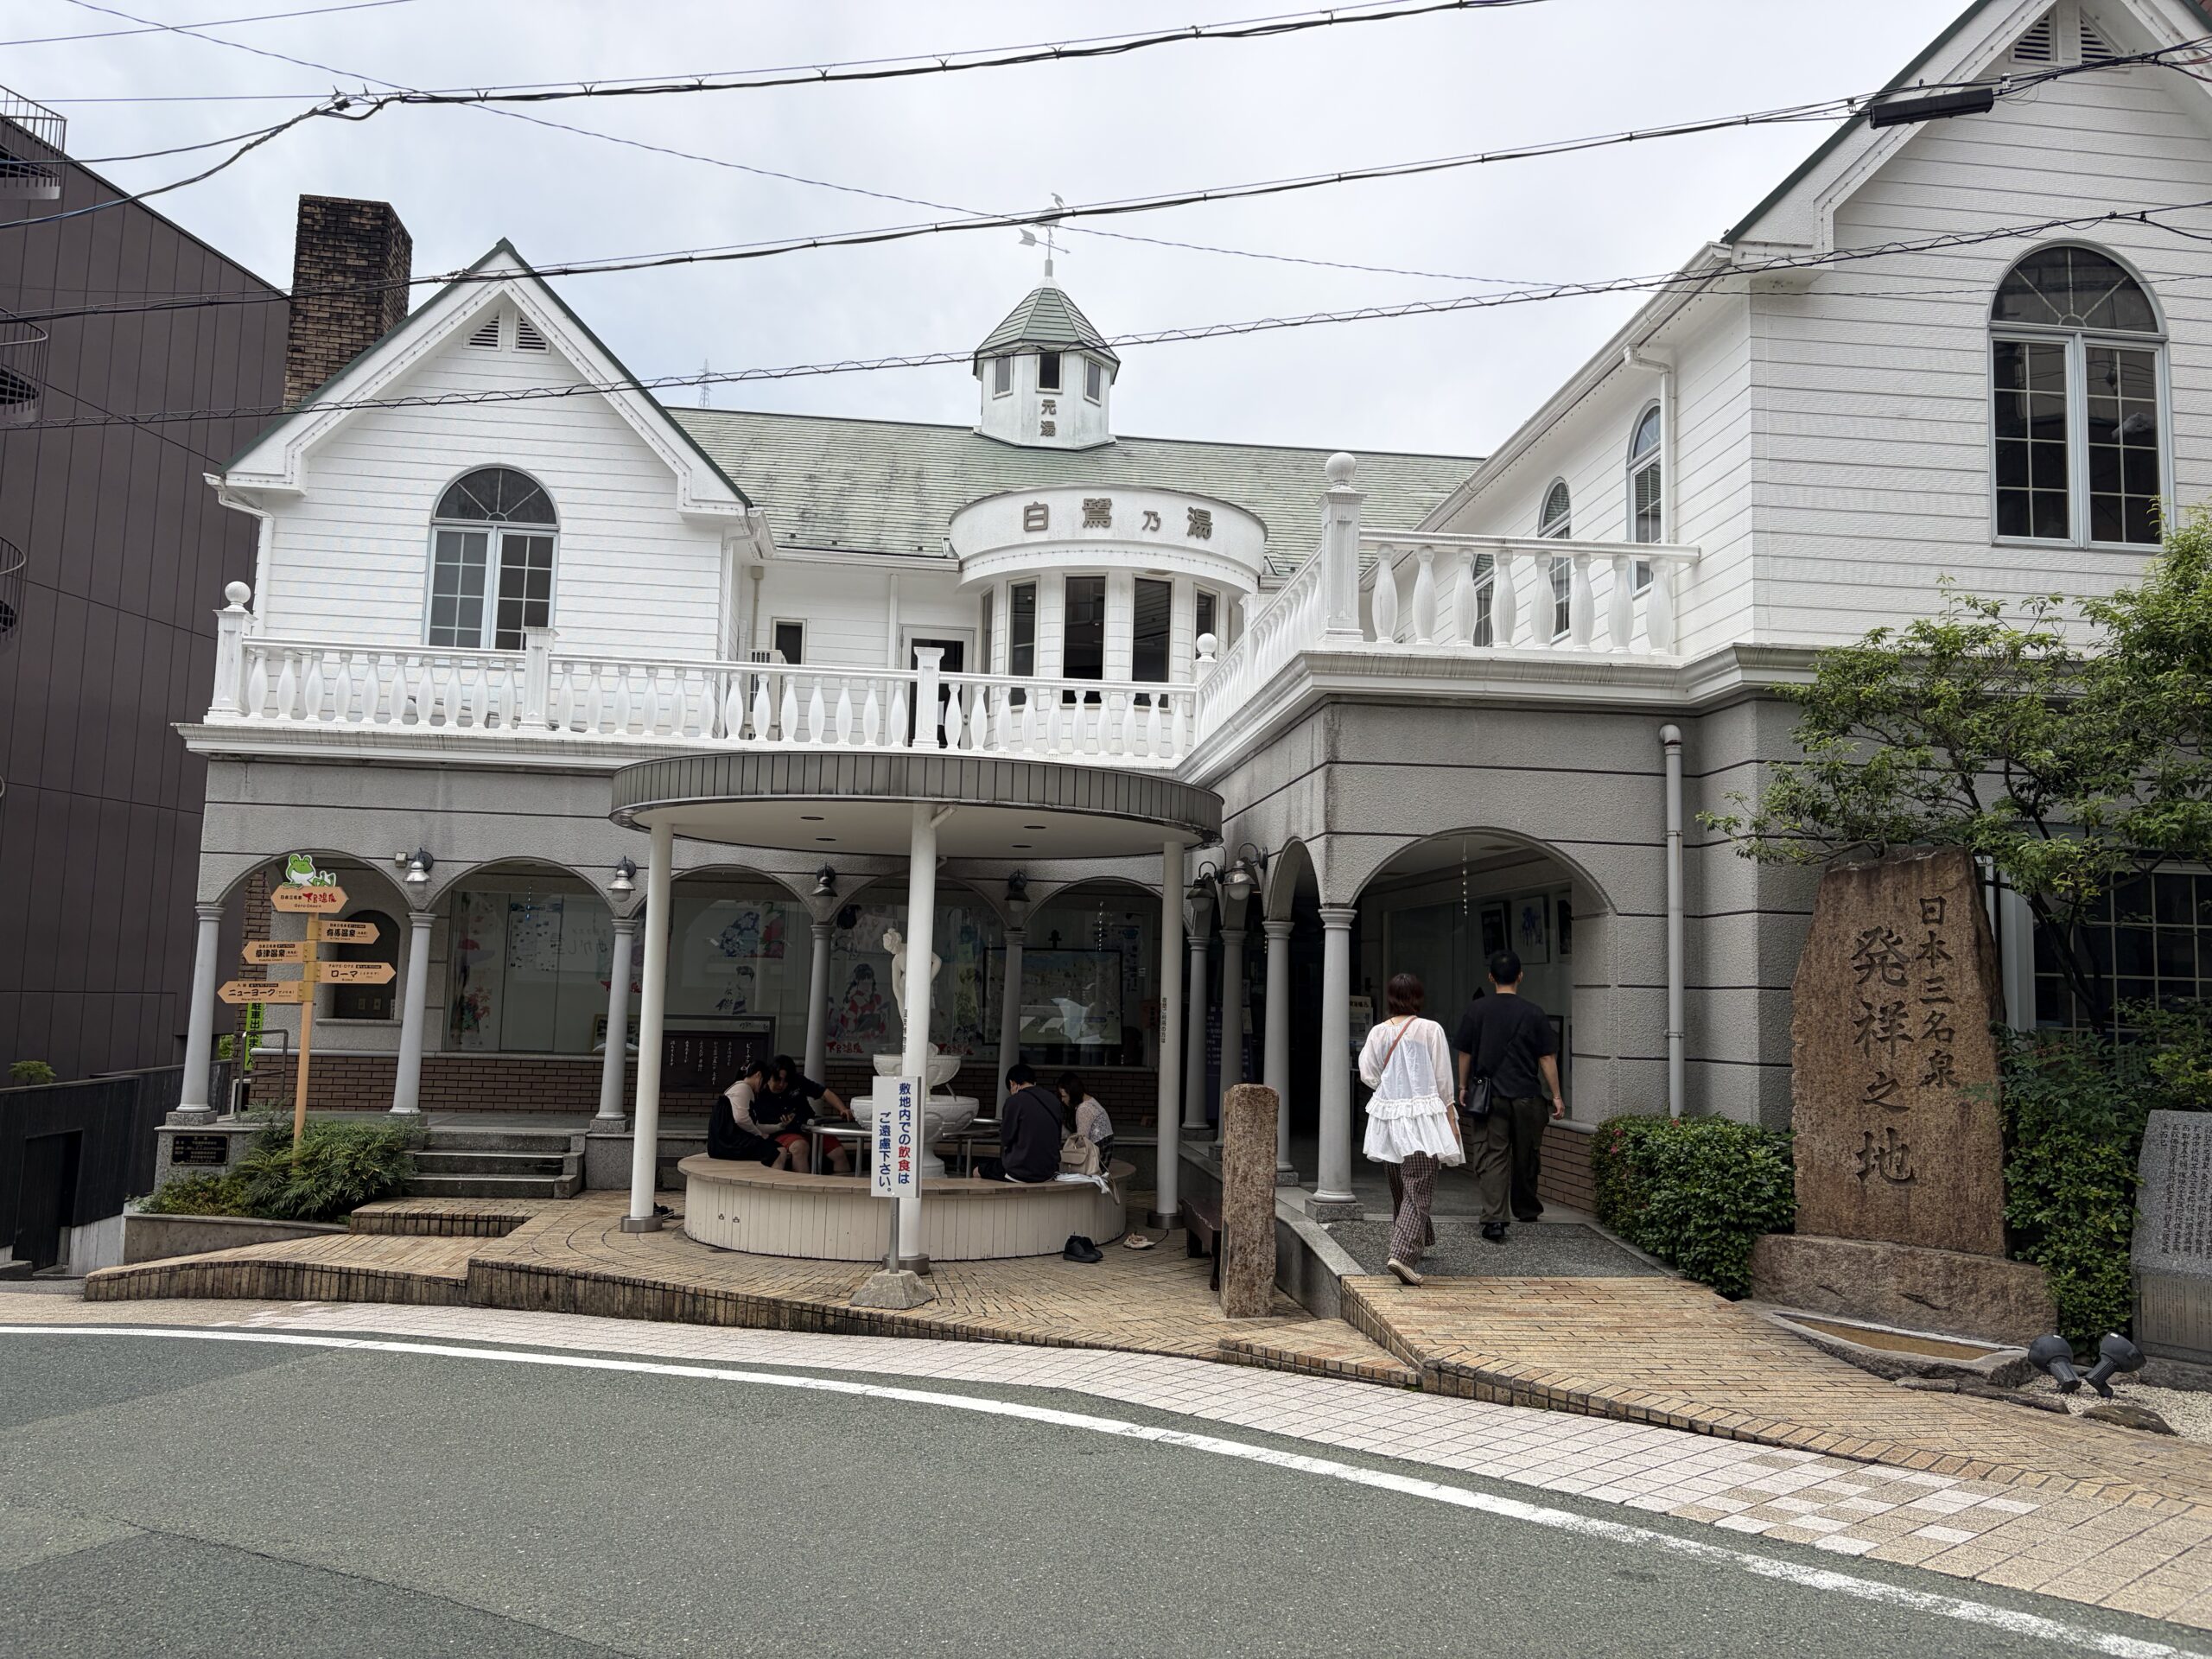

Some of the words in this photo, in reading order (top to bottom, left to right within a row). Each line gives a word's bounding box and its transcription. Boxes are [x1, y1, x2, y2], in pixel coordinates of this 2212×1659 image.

[1040, 398, 1057, 436] 元湯
[1023, 498, 1213, 540] 白鷺乃湯
[302, 892, 337, 904] 下呂温泉
[256, 949, 285, 957] 草津温泉
[327, 928, 356, 938] 有馬温泉
[331, 969, 358, 978] ローマ
[1916, 895, 1961, 1090] 日本三名泉
[1851, 925, 1918, 1188] 発祥之地
[879, 1111, 892, 1192] ご遠慮下さい。
[898, 1082, 912, 1185] 敷地内での飲食は
